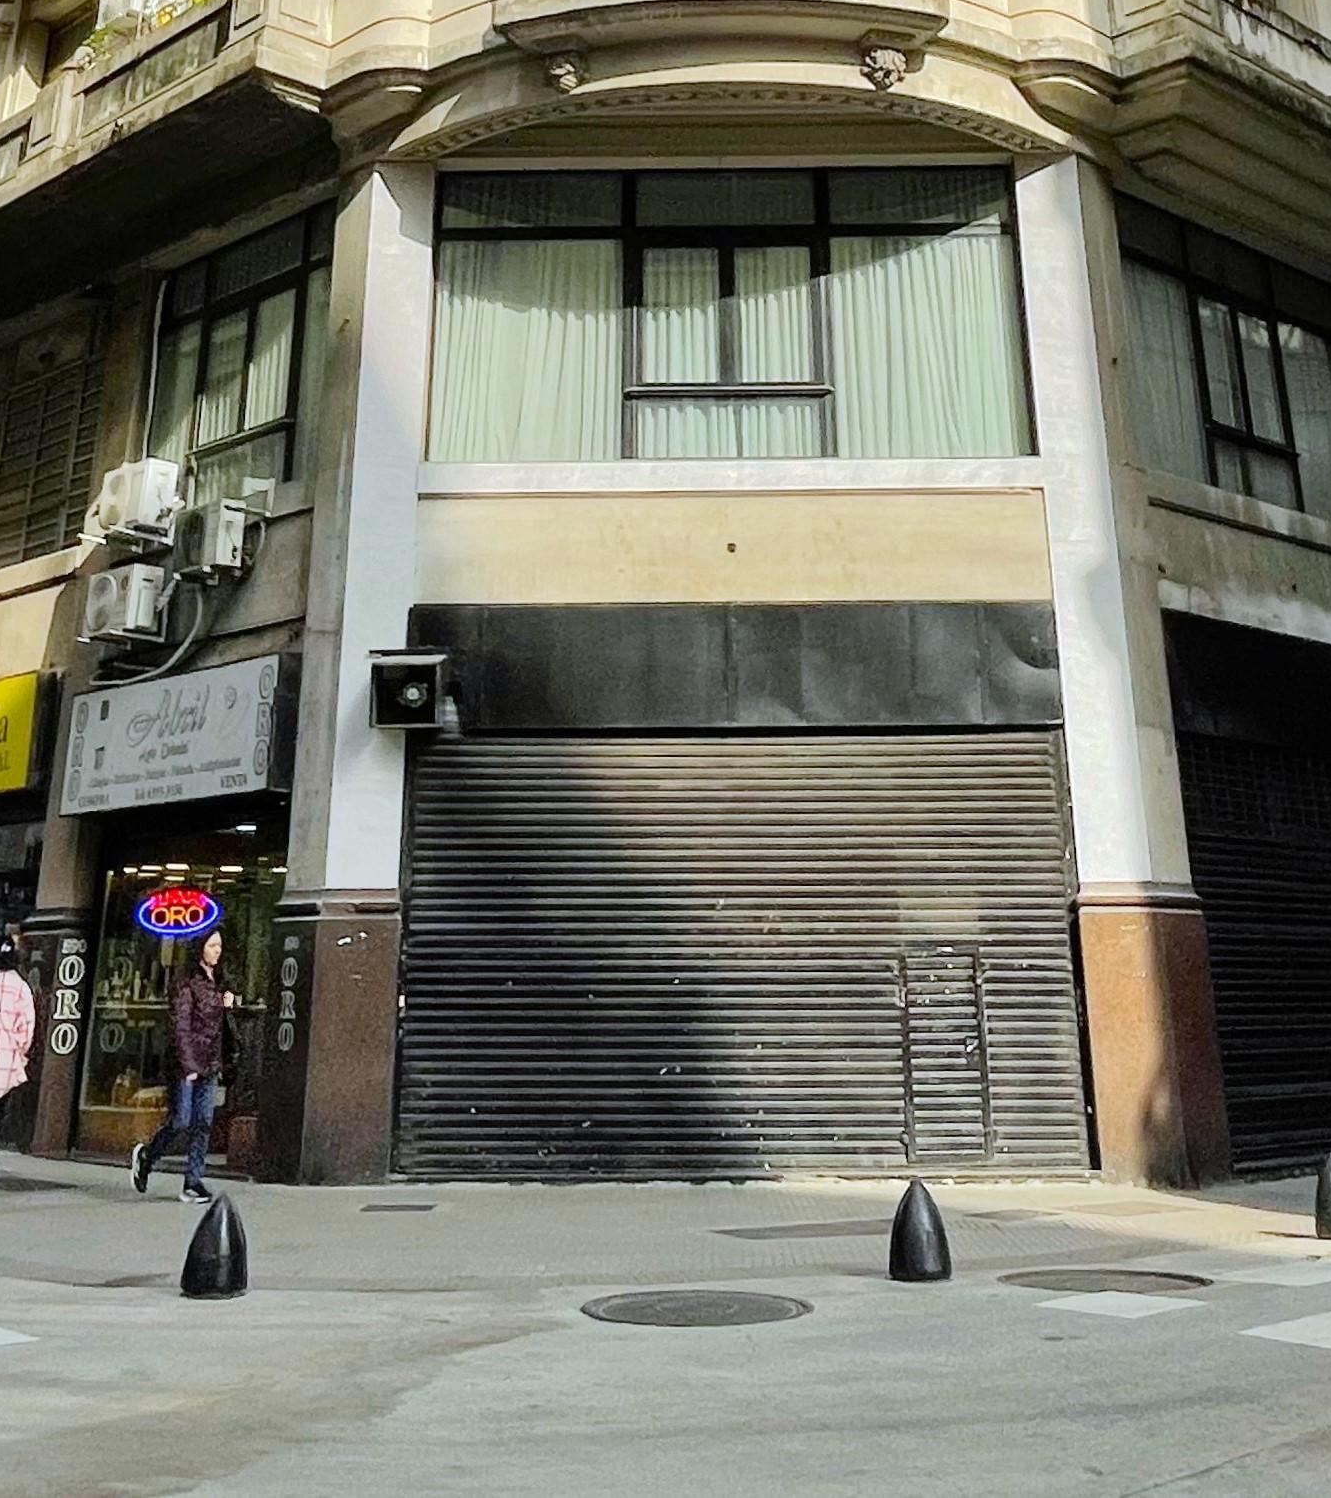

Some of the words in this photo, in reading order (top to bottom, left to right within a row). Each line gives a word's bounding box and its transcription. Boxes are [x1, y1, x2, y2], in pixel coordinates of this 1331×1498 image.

[126, 684, 210, 748] Abril
[150, 906, 205, 927] ORO
[51, 954, 86, 1055] ORO
[277, 956, 299, 1052] ORO
